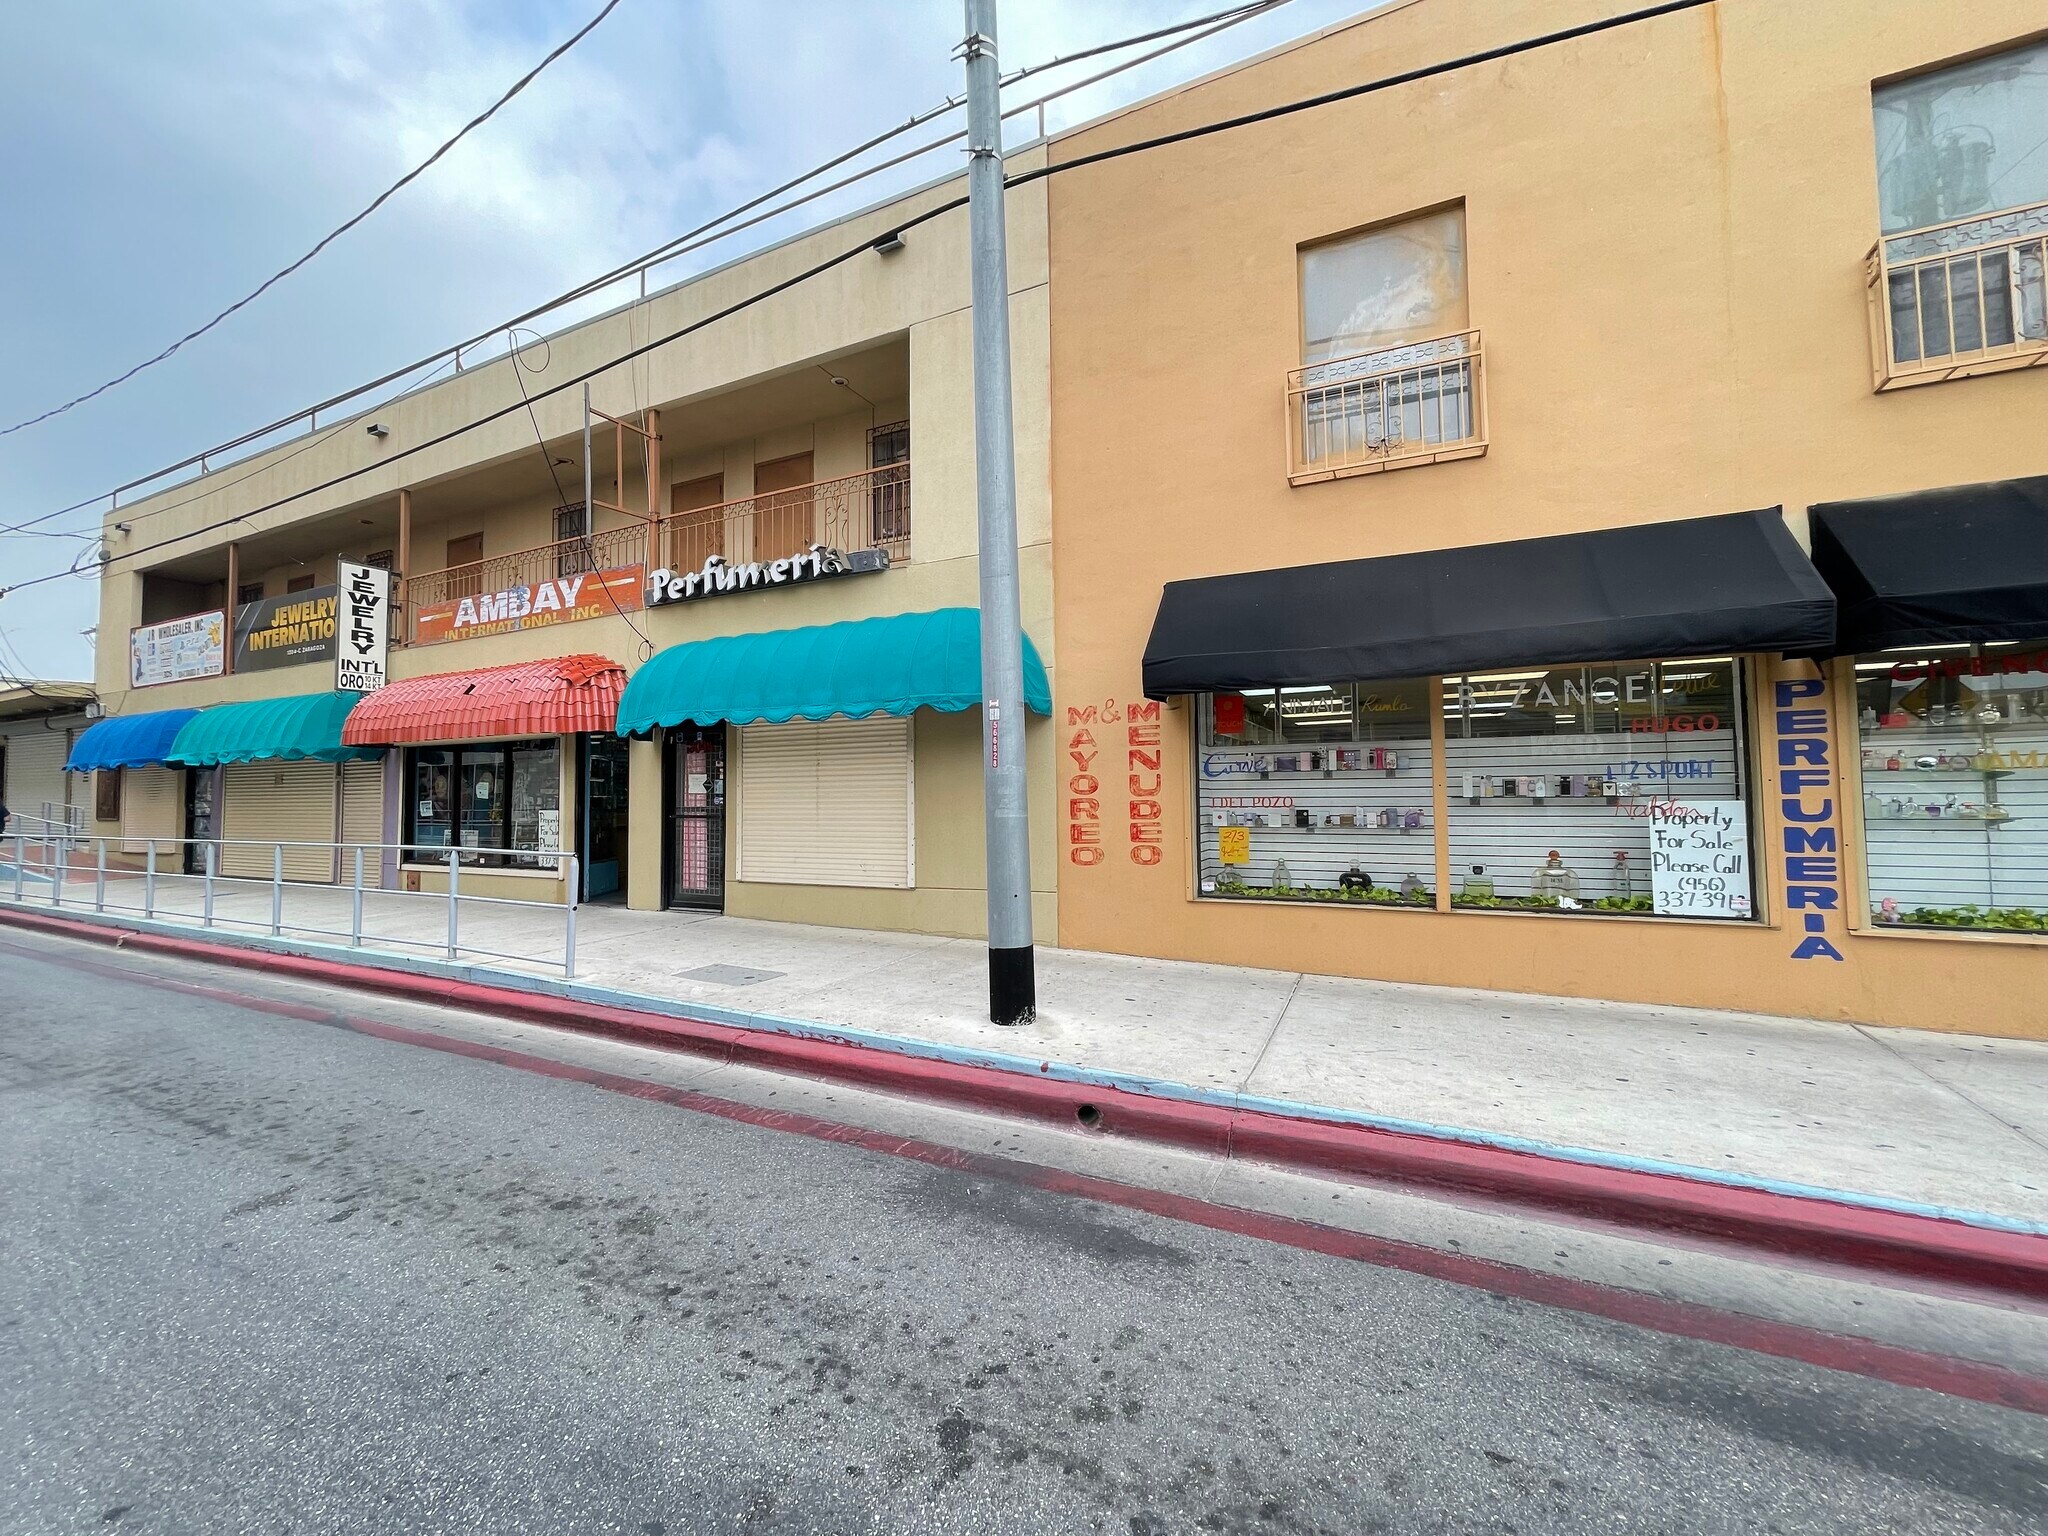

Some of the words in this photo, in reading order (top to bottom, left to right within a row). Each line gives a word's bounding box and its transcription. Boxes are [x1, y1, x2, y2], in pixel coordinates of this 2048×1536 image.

[650, 543, 852, 602] Perfumeria
[271, 596, 337, 627] JEWELRY
[347, 569, 381, 655] JEWELRY
[454, 576, 585, 627] AMBAY
[571, 603, 603, 620] INC.
[250, 618, 337, 651] INTERNATIO
[341, 659, 383, 674] INT'L
[341, 673, 364, 689] ORO
[1457, 675, 1647, 711] BYZANCE
[1101, 698, 1121, 724] &
[1632, 712, 1720, 733] HUGO
[1068, 705, 1104, 866] MAYOREO
[1128, 700, 1162, 866] MENUDEO
[1651, 805, 1734, 831] Property
[1776, 679, 1844, 961] PERFUMERIA
[1655, 830, 1688, 849] For
[1691, 830, 1733, 850] Sale
[1652, 852, 1709, 874] Please
[1713, 854, 1742, 874] Call
[1678, 877, 1726, 892] (956)
